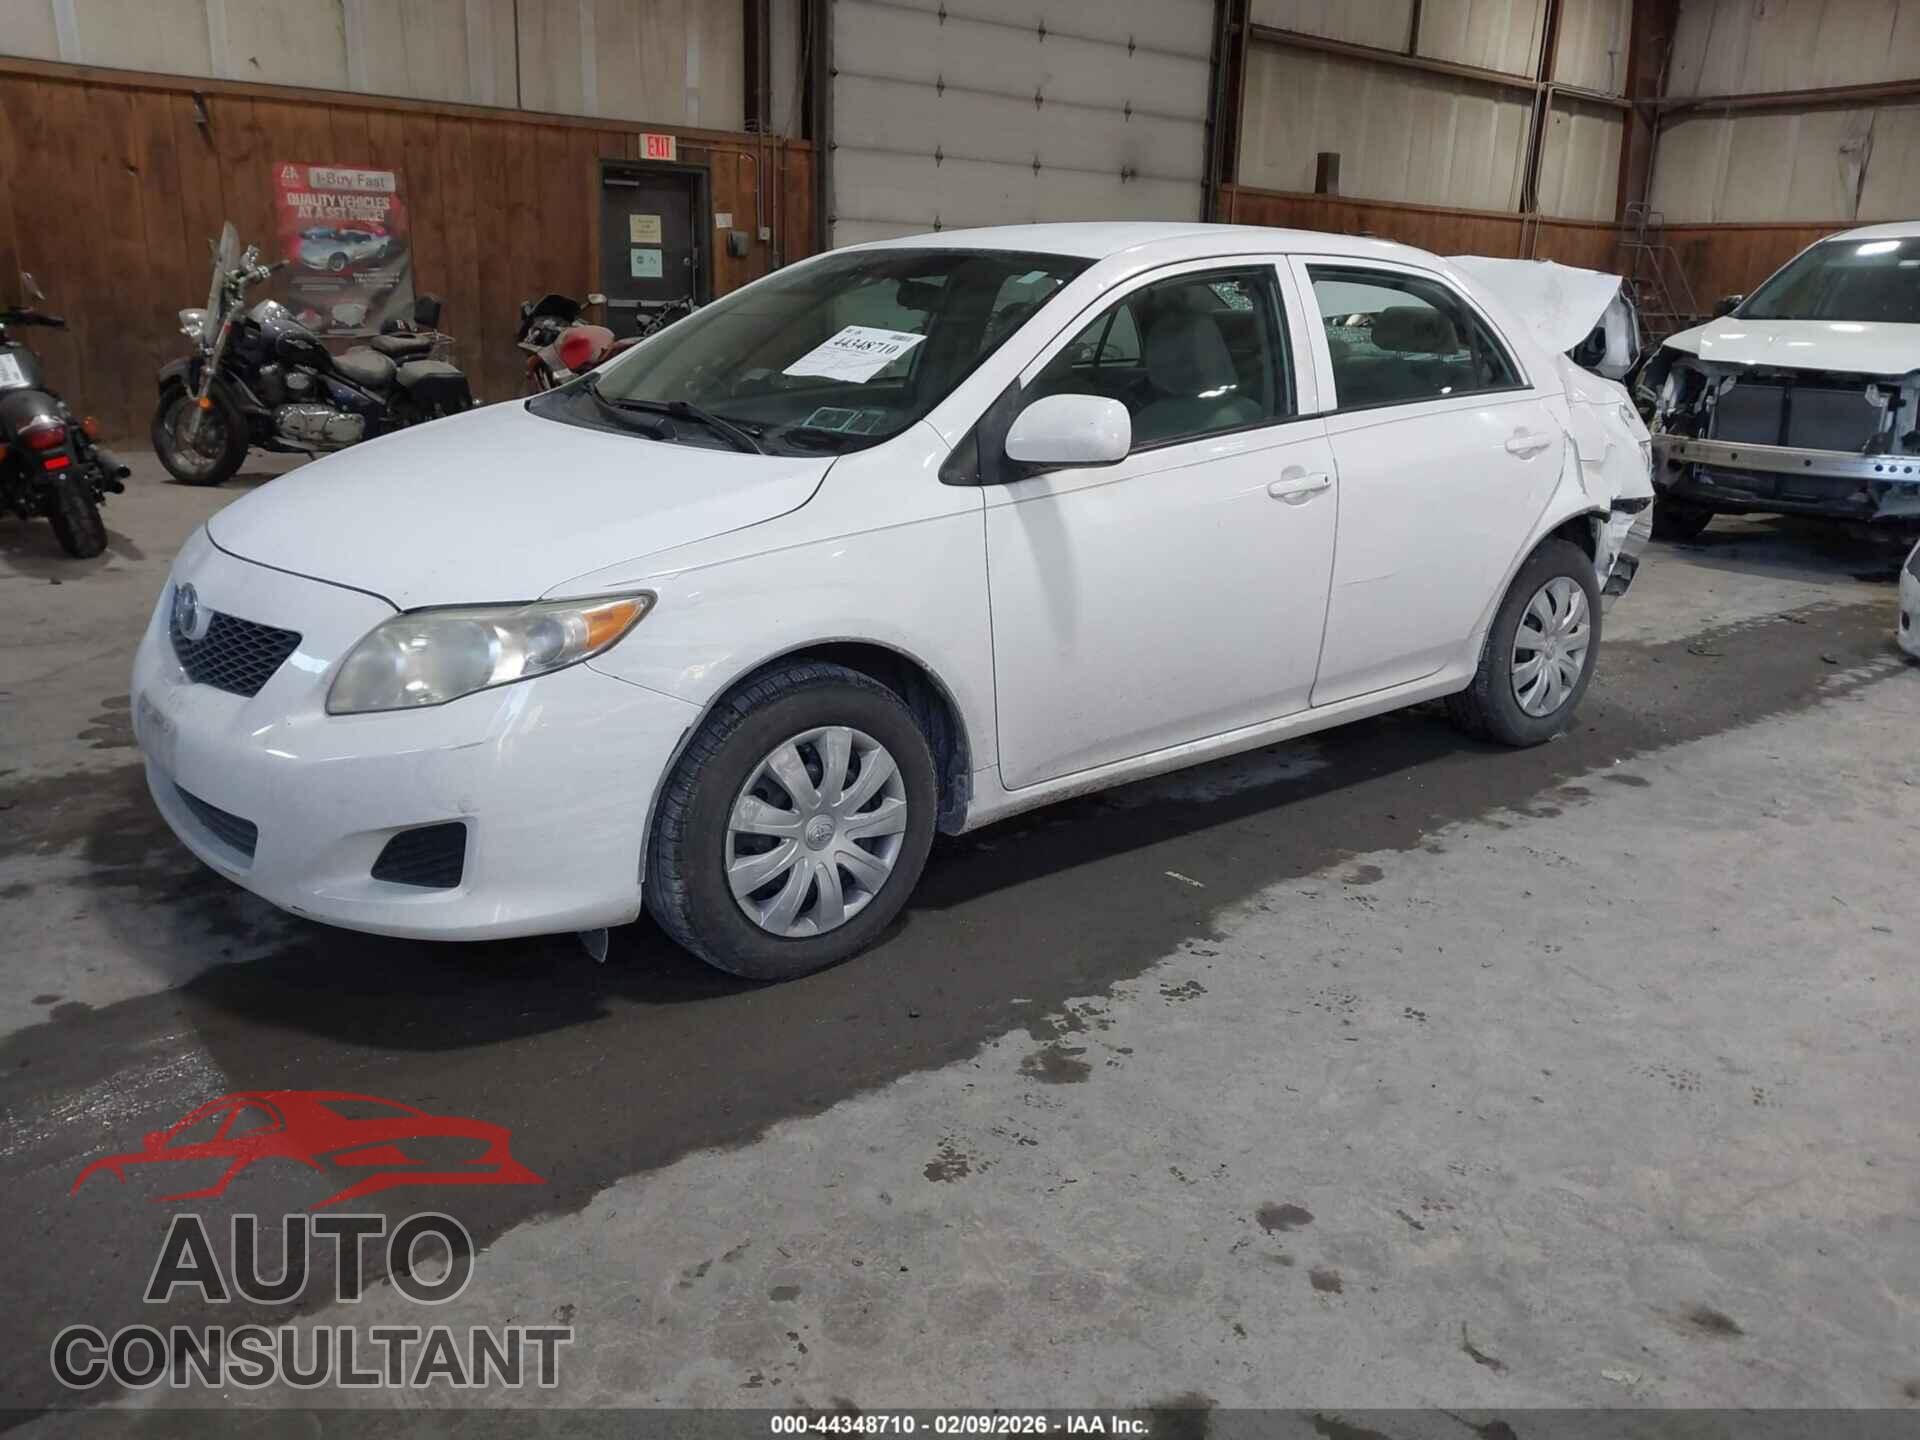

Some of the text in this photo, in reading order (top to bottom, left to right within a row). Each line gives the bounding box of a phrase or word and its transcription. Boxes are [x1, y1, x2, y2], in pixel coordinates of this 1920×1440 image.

[647, 134, 671, 158] EXIT
[358, 173, 385, 188] Fast
[287, 192, 391, 210] QUALITY VEHICLES
[297, 206, 311, 217] AT
[312, 206, 323, 217] A
[834, 336, 900, 354] 44348710
